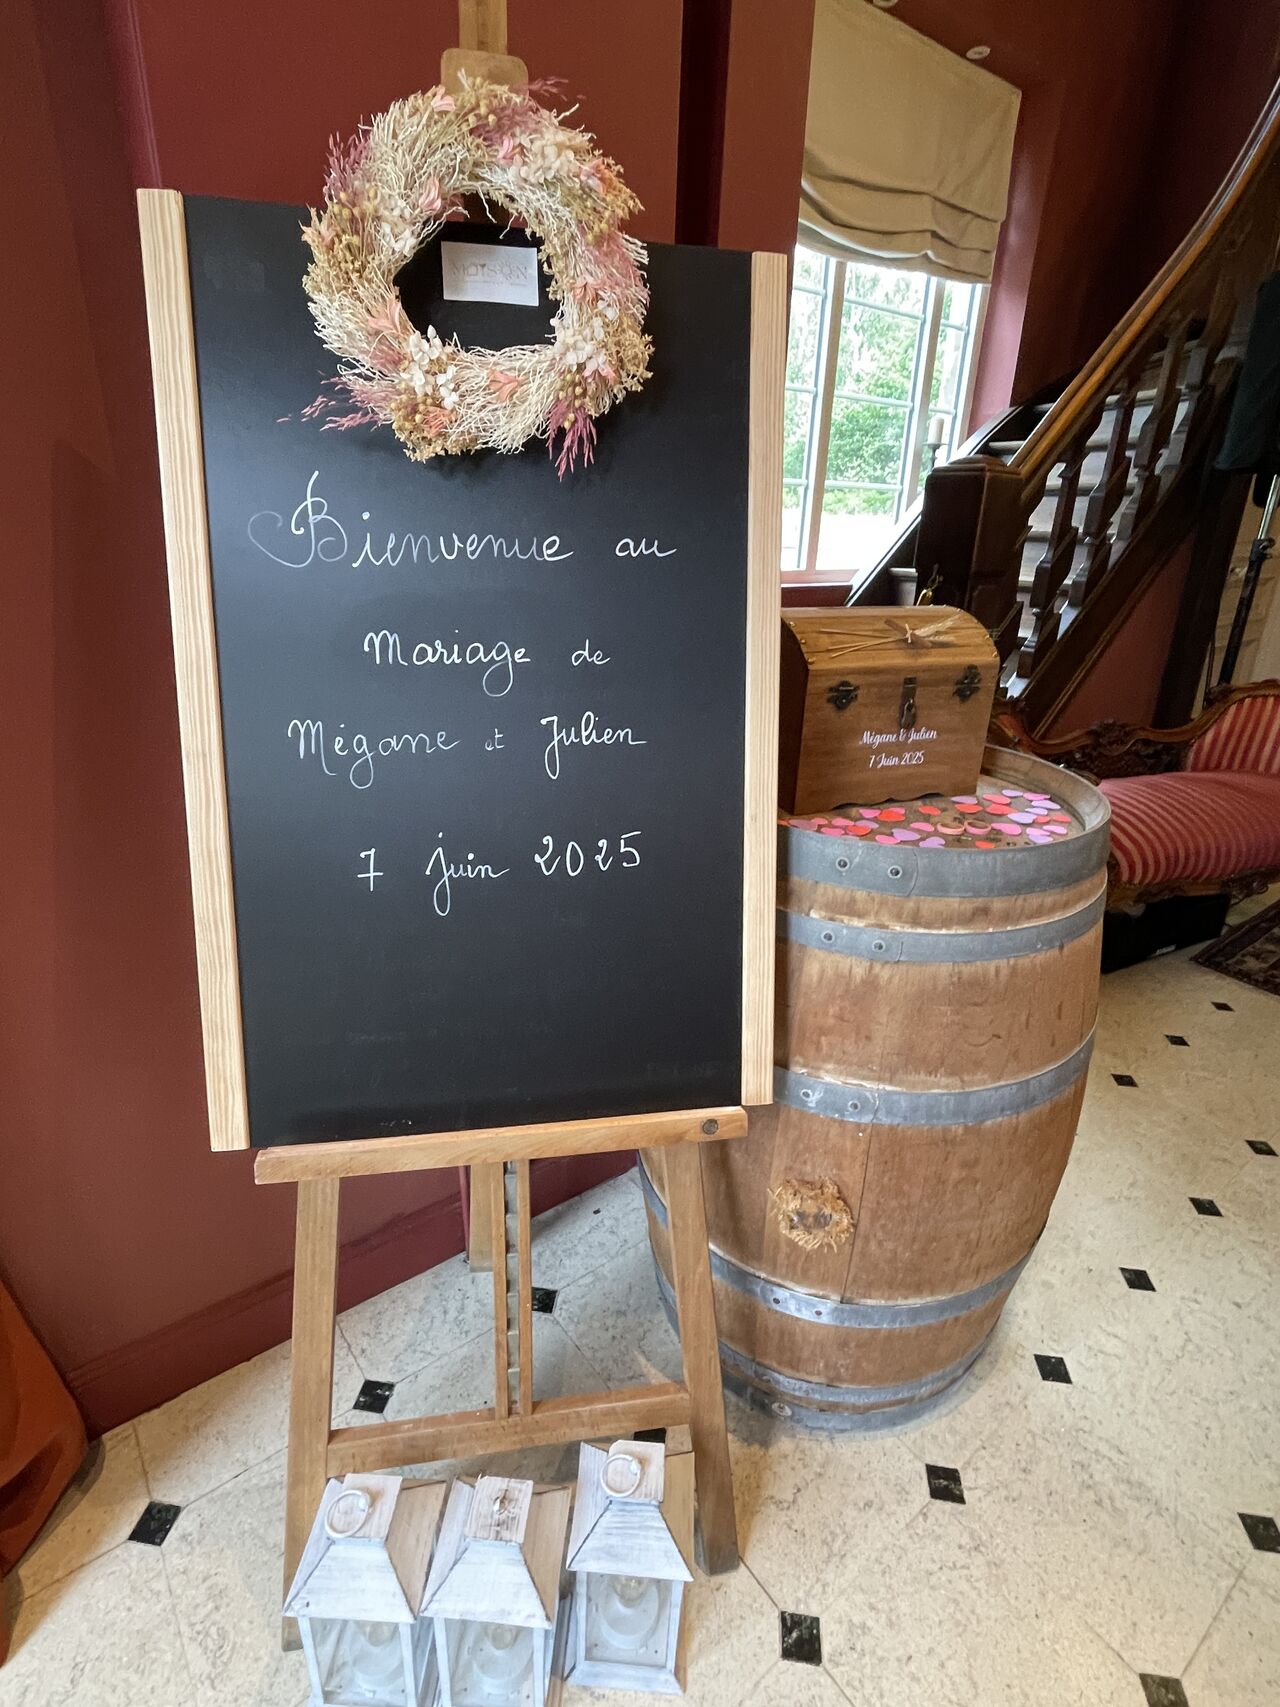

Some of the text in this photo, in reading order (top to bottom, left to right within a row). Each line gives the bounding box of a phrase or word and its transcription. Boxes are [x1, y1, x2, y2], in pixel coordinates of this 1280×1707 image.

[248, 470, 677, 568] Bienvenue au
[363, 629, 611, 697] Mariage de
[287, 711, 647, 789] Mégane et Julien
[869, 750, 925, 769] 7 Juin 2025
[907, 726, 937, 744] Julien
[357, 831, 642, 916] 7 juin 2025
